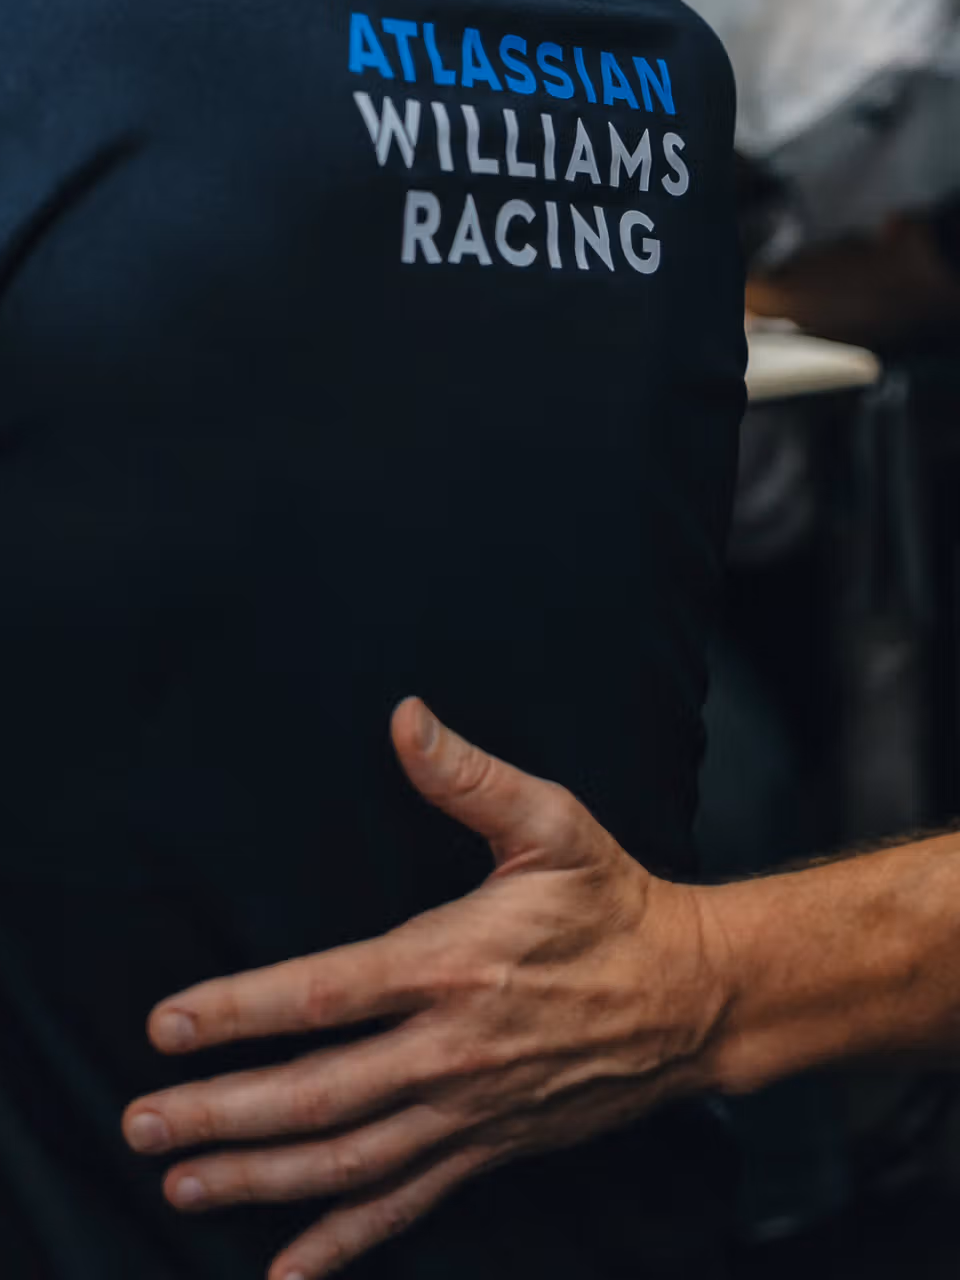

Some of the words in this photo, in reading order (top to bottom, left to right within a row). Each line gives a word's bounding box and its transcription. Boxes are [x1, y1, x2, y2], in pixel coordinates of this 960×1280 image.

[348, 11, 676, 116] ATLASSIAN
[352, 90, 690, 197] WILLIAMS
[400, 188, 662, 275] RACING
